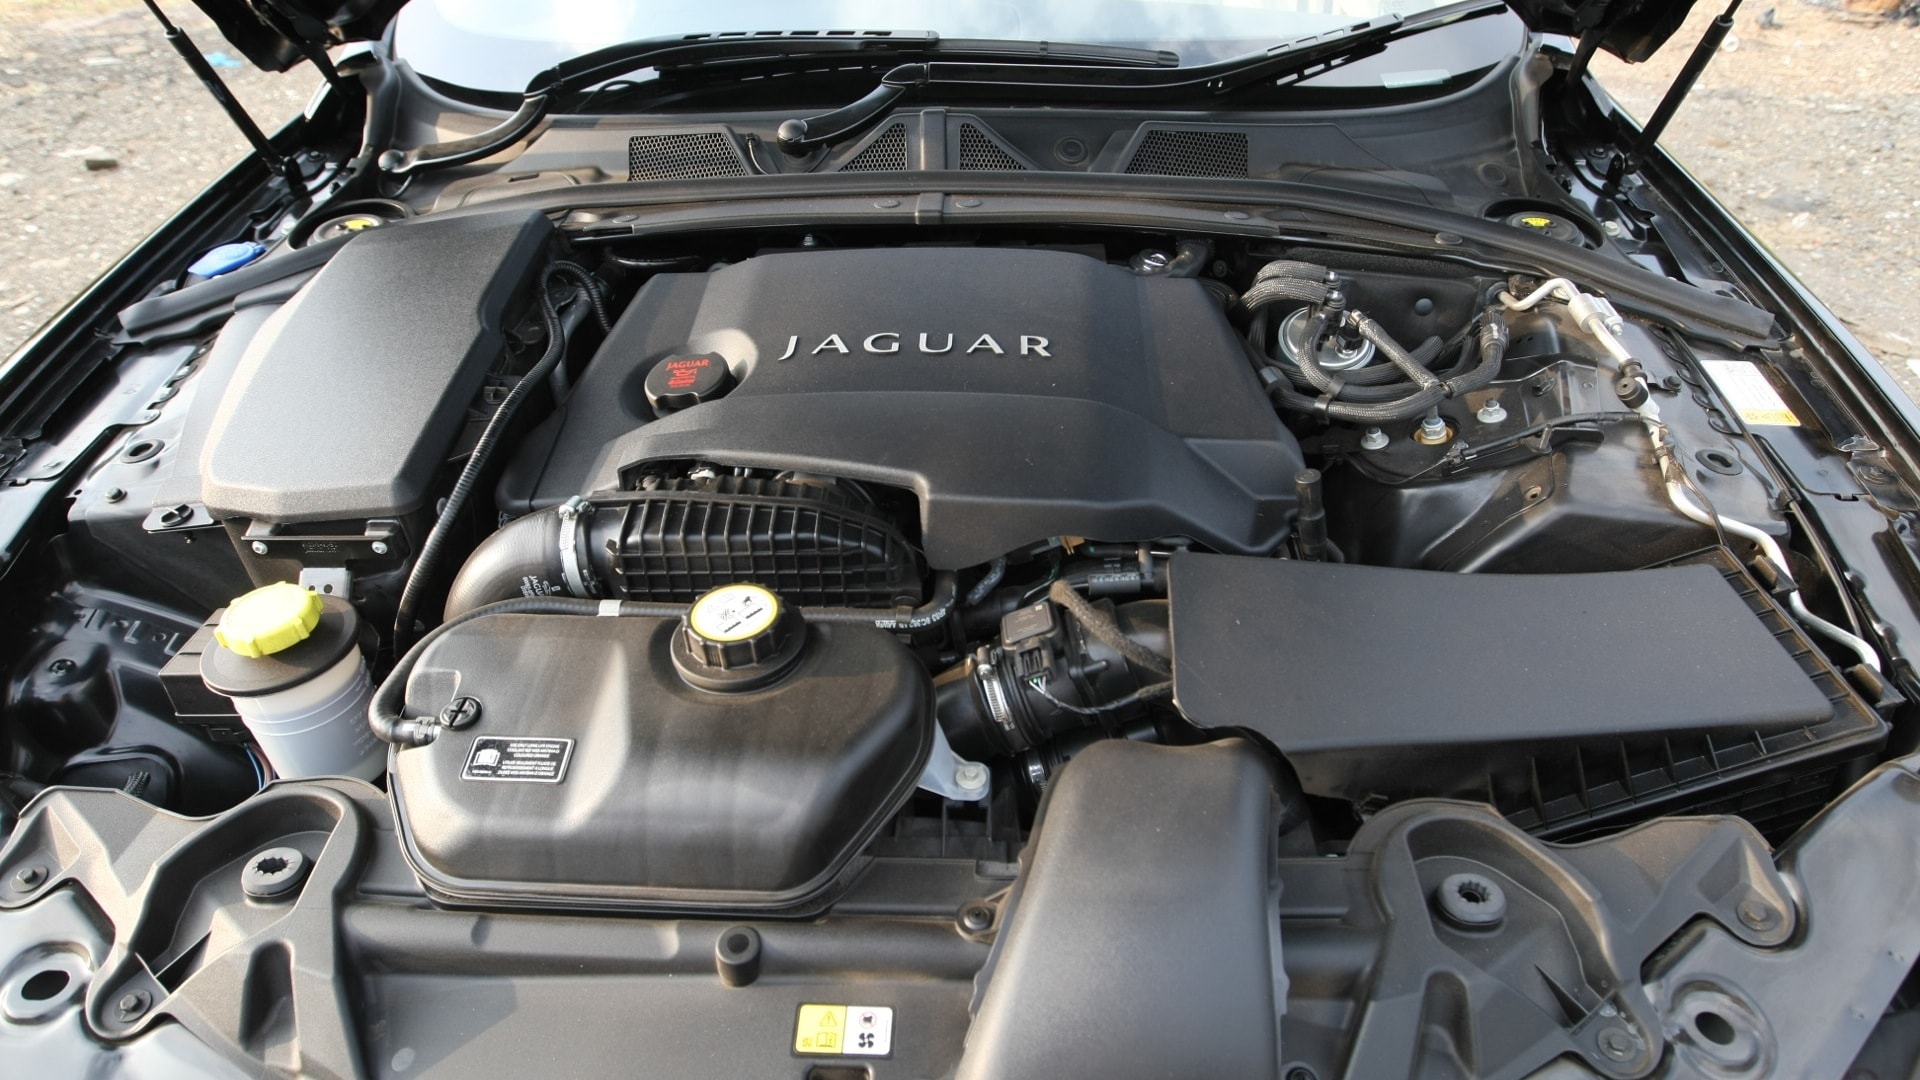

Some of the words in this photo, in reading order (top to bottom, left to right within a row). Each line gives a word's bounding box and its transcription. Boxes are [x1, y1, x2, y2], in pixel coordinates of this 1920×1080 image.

[778, 332, 1052, 361] JAGUAR
[666, 359, 710, 371] JAGUAR
[529, 575, 545, 597] JAGU
